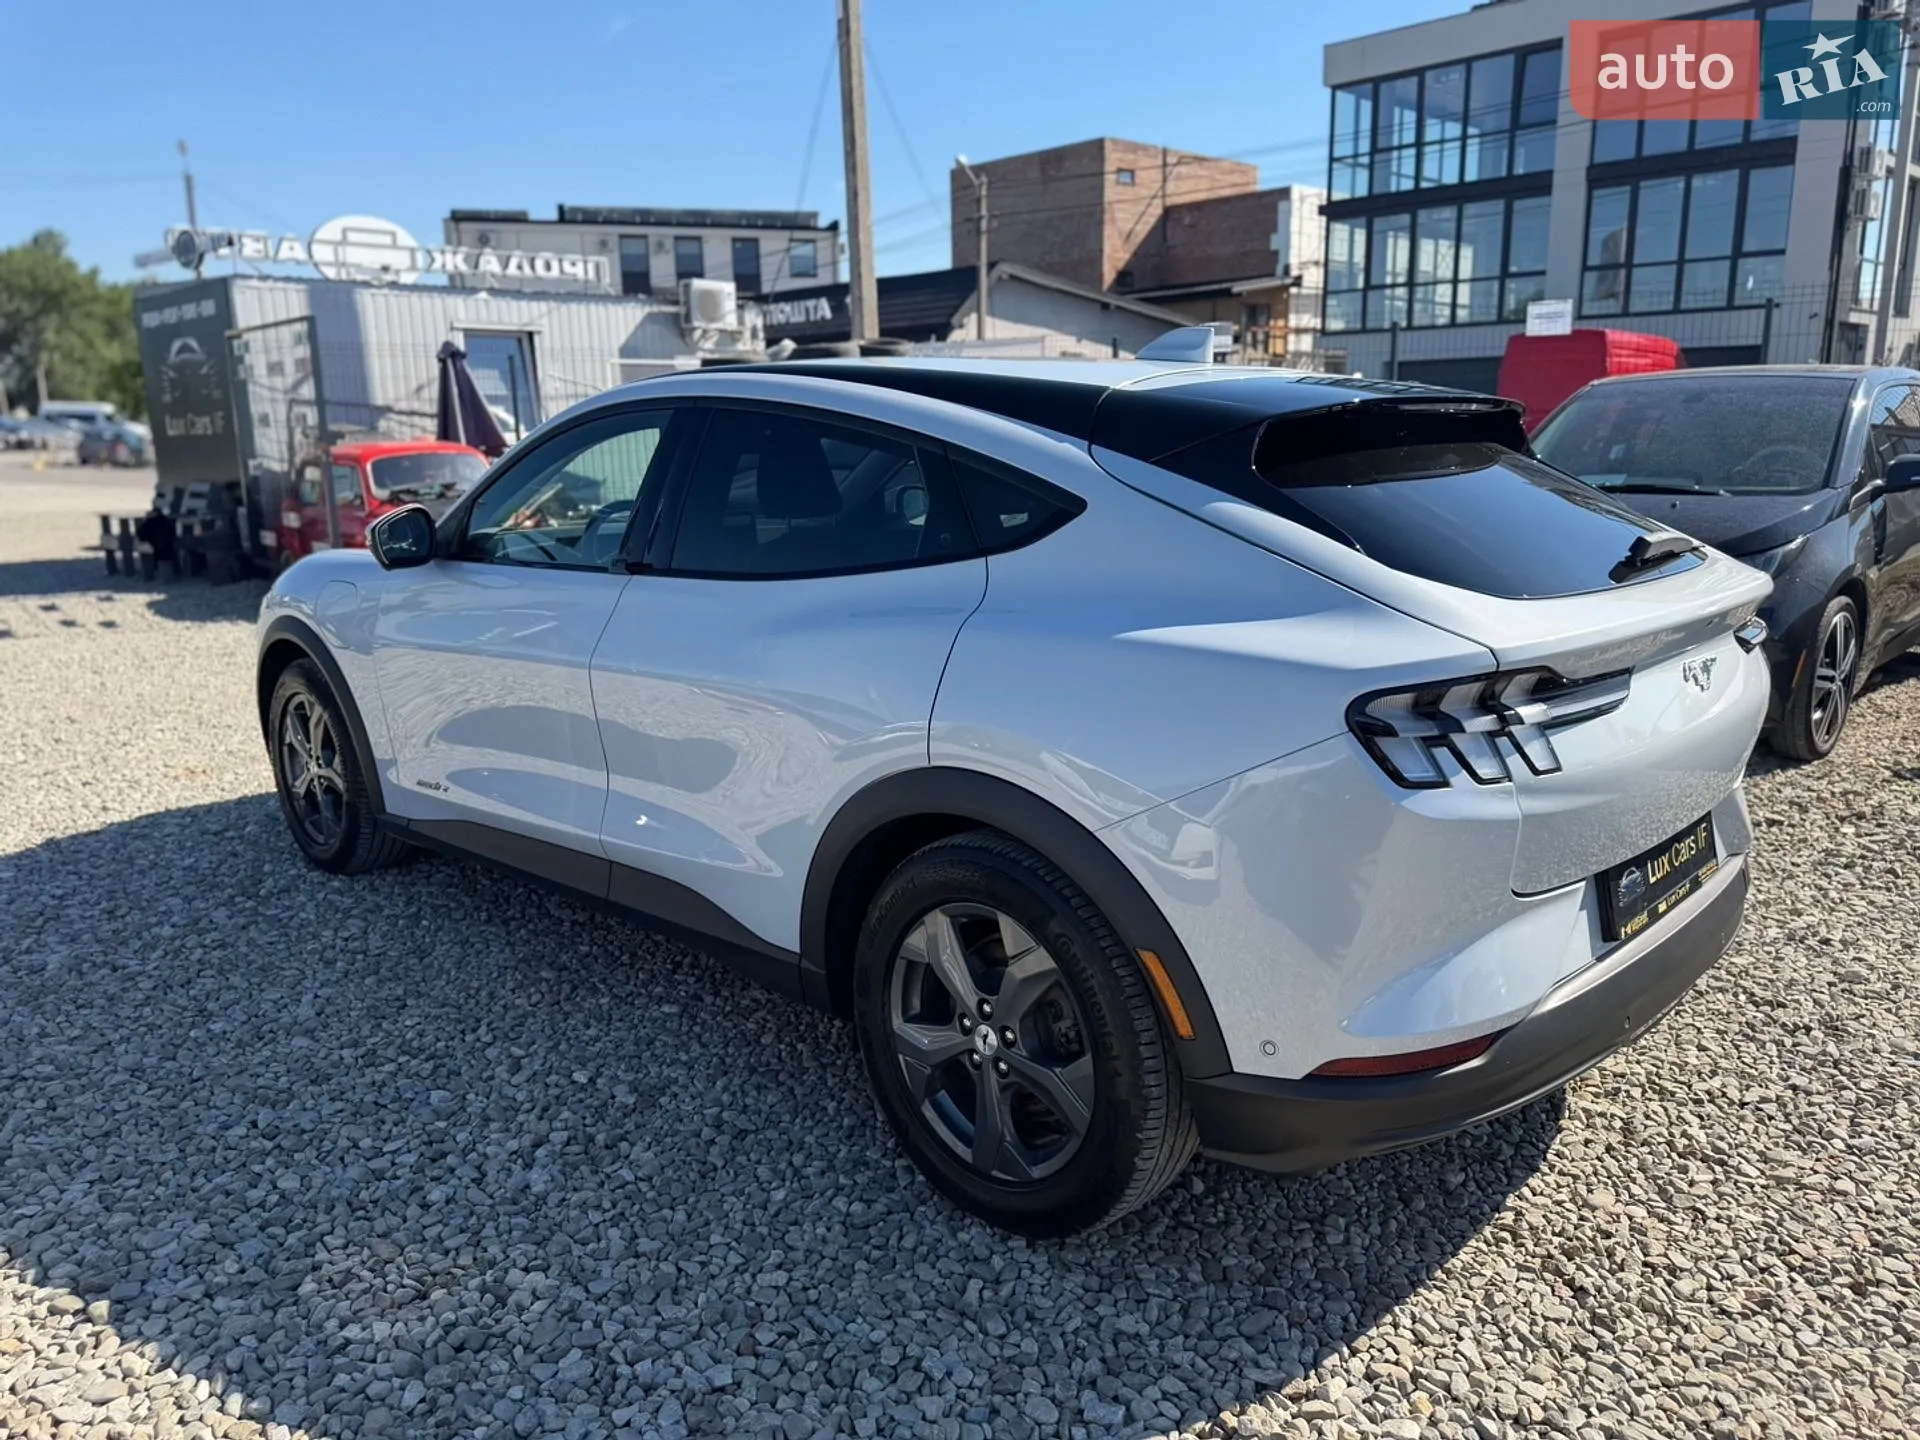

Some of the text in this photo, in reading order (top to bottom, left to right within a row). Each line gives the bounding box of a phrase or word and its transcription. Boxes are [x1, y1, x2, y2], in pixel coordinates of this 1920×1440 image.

[765, 296, 833, 326] ПОШТА
[1646, 851, 1671, 884] Lux
[1671, 834, 1696, 867] Cars
[1697, 821, 1708, 851] IF
